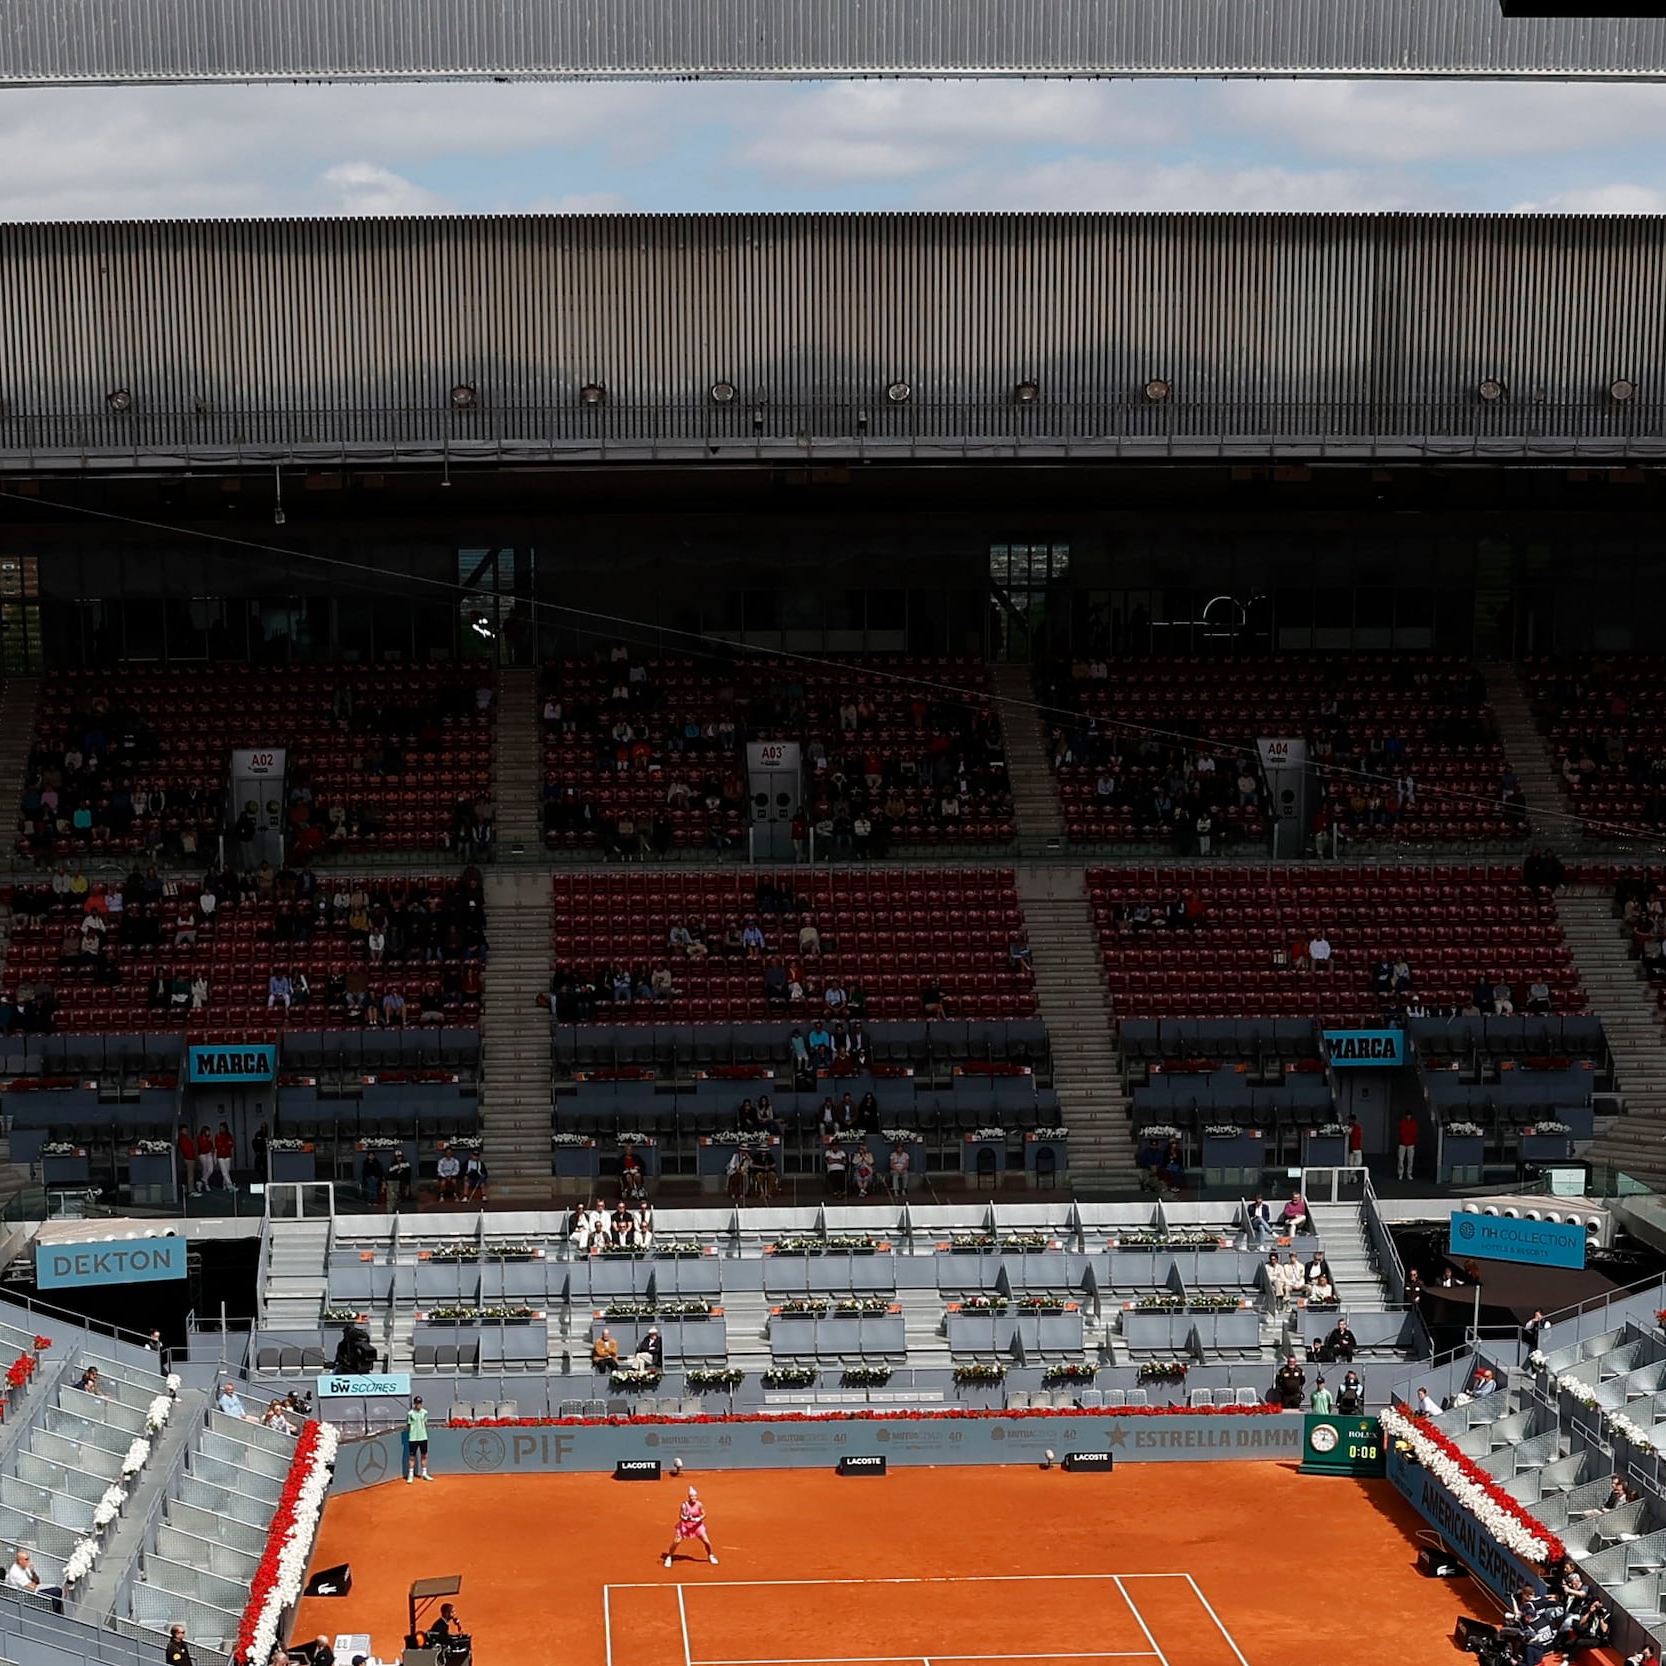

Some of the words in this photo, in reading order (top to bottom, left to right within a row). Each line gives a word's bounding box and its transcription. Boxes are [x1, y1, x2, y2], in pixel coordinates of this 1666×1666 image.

[762, 747, 781, 758] A03
[1268, 743, 1287, 754] A04
[251, 754, 273, 766] A02
[1325, 1037, 1396, 1059] MARCA
[198, 1053, 270, 1075] MARCA
[1500, 1229, 1576, 1248] COLLECTION
[53, 1249, 171, 1277] DEKTON
[351, 1382, 397, 1393] SCORES
[1134, 1429, 1228, 1449] ESTRELLA
[1234, 1428, 1297, 1447] DAMM
[1349, 1431, 1377, 1439] ROLEX
[513, 1434, 575, 1465] PIF
[1349, 1445, 1376, 1459] 0:08
[847, 1457, 881, 1465] LACOSTE
[1074, 1453, 1108, 1461] LACOSTE
[622, 1461, 656, 1470] LACOSTE
[1421, 1481, 1475, 1557] AMERICAN
